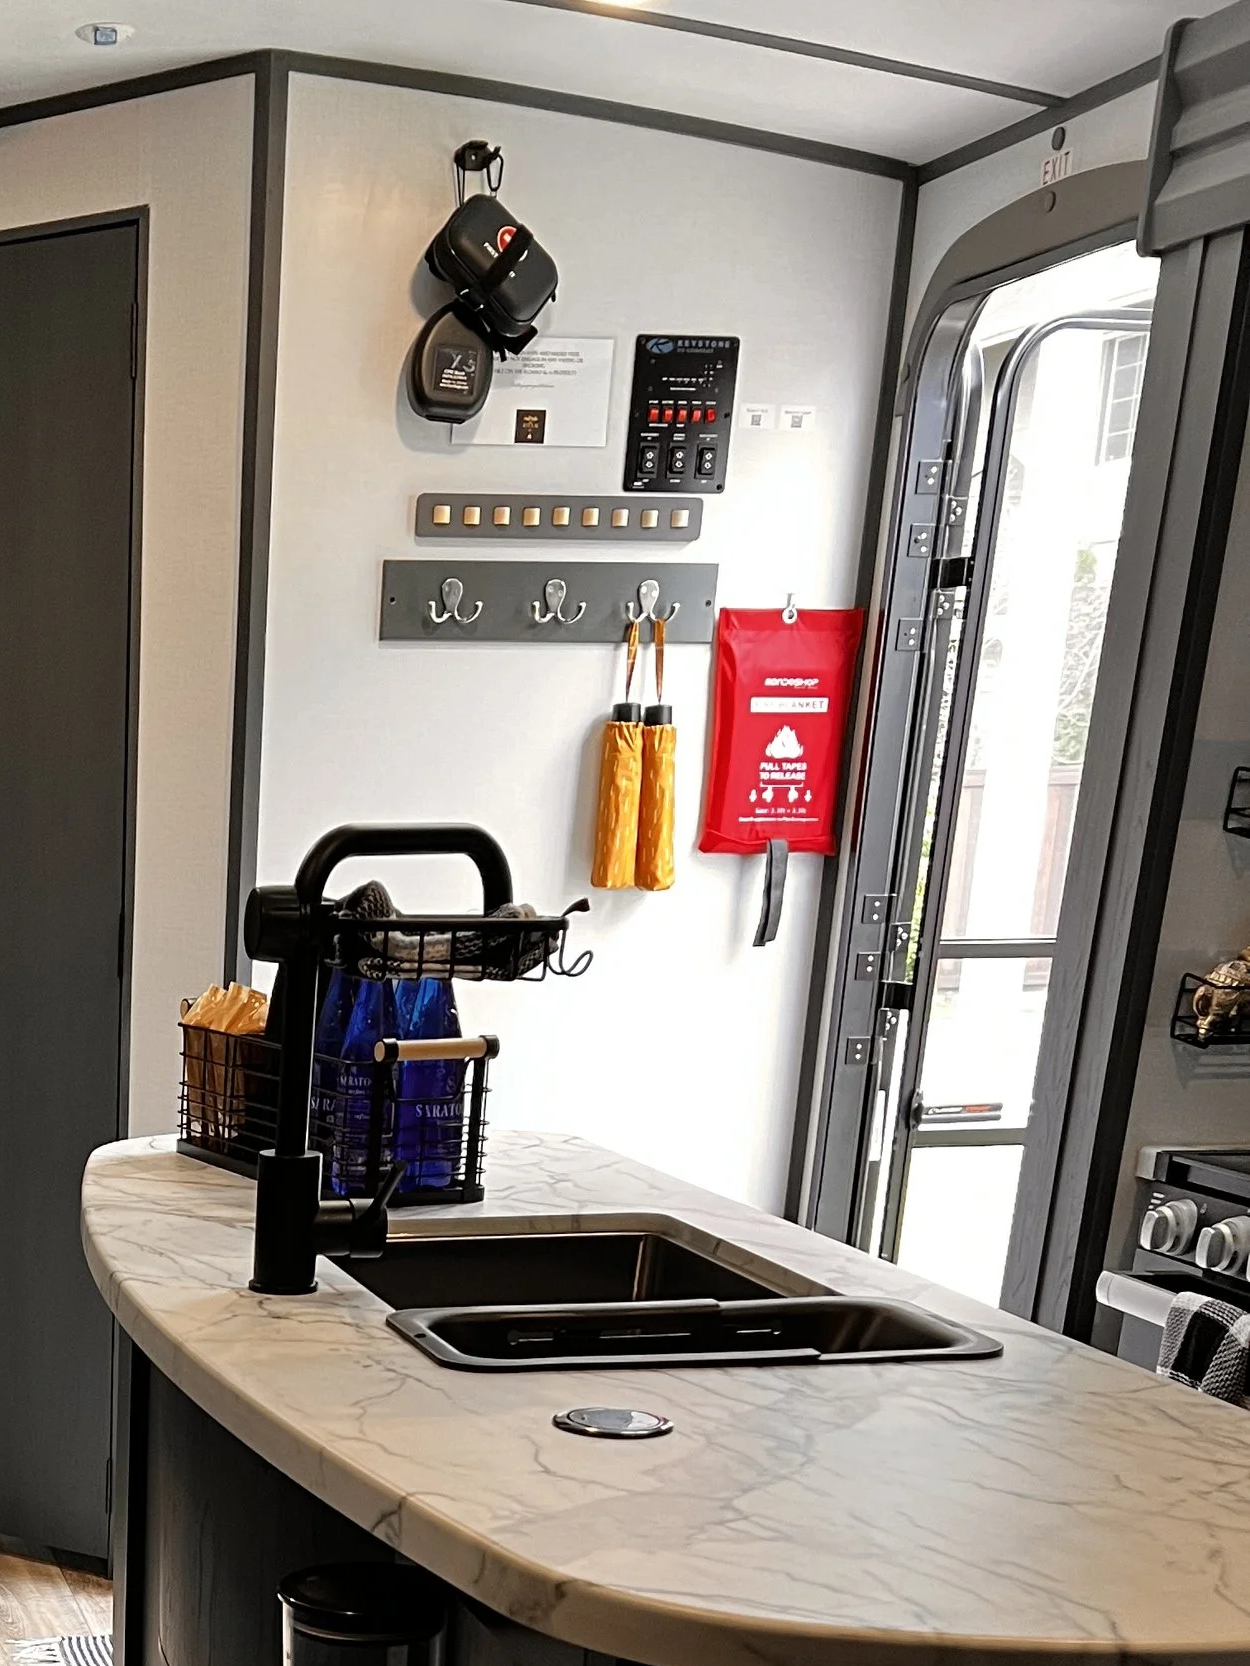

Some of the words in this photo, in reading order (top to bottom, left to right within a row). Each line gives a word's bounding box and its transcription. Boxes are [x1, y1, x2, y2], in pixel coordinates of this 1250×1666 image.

[1042, 150, 1071, 186] EXIT
[677, 340, 730, 348] KEYSTONE
[760, 762, 780, 771] PULL
[781, 762, 807, 771] TAPES
[759, 771, 770, 780] TO
[770, 771, 806, 780] RELEASE
